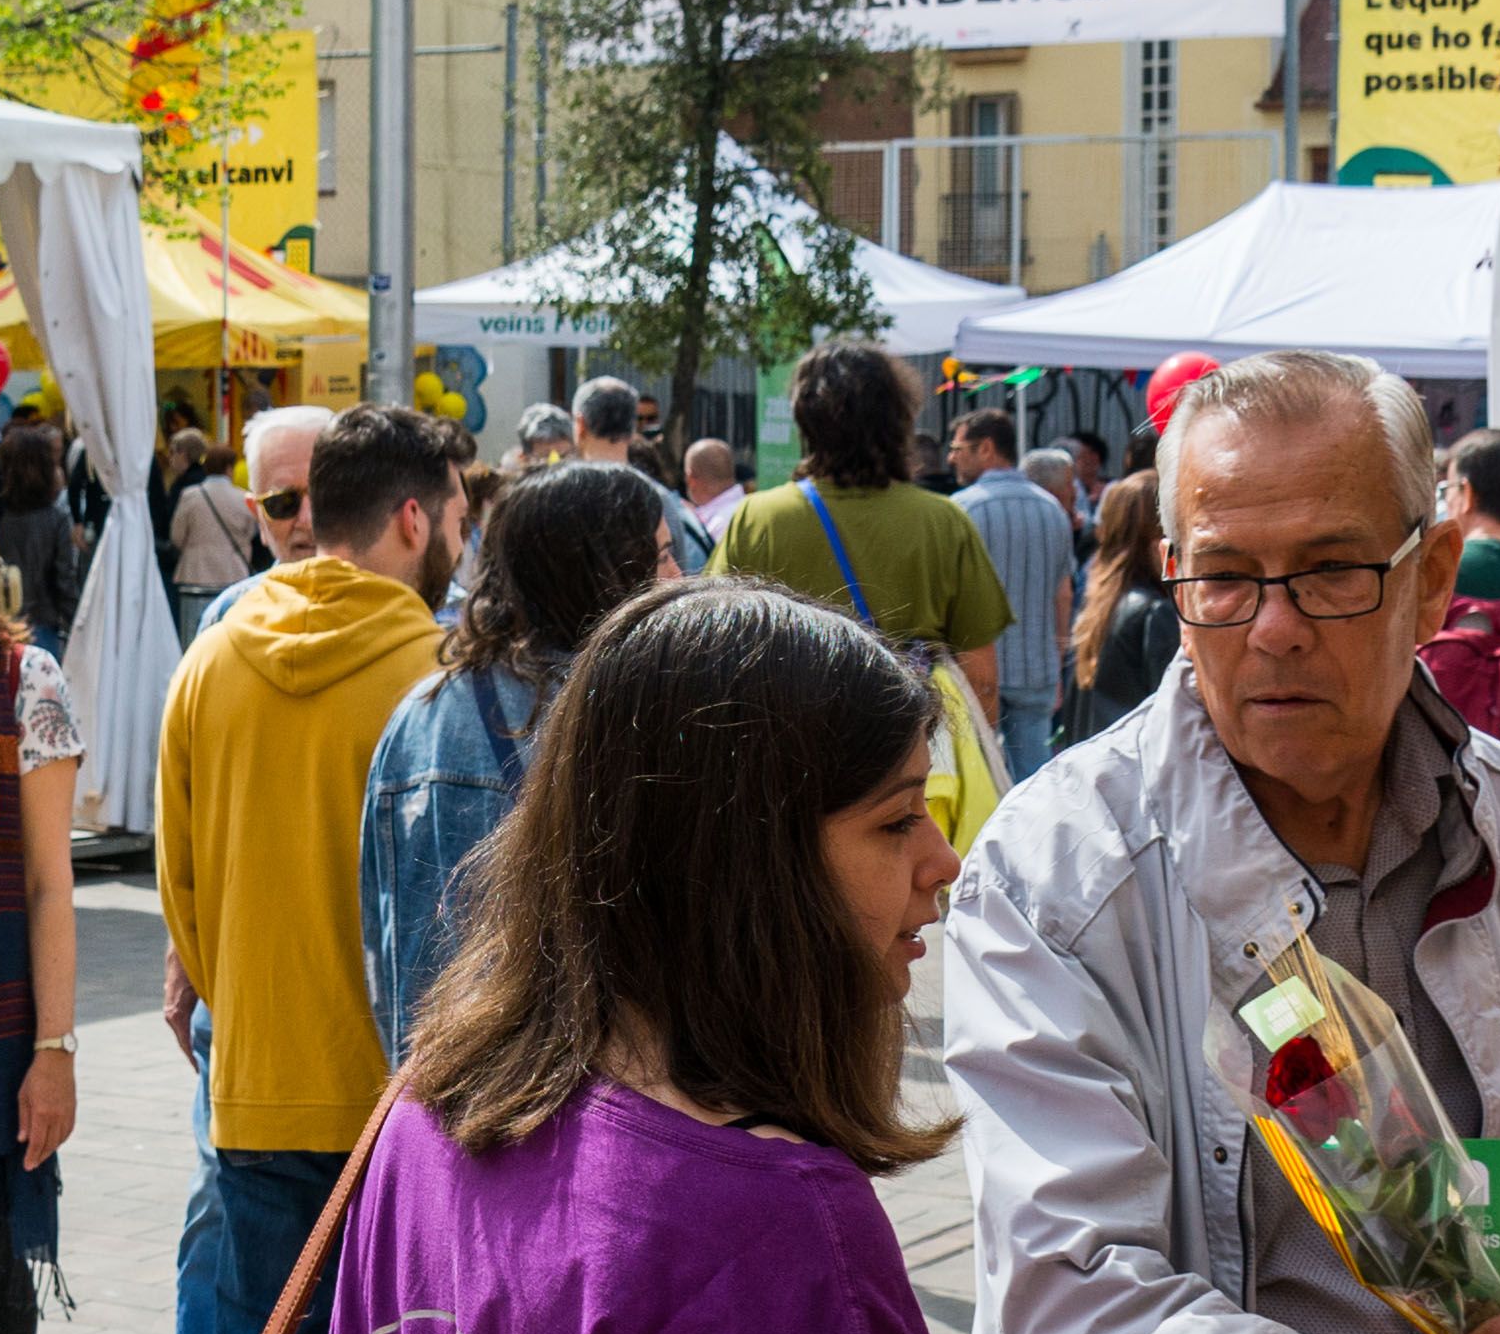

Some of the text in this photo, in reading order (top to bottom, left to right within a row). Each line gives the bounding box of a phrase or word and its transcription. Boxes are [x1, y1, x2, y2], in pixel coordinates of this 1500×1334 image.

[1364, 31, 1423, 56] que
[1432, 22, 1472, 49] ho
[1364, 64, 1499, 98] possible
[226, 158, 293, 184] canvi
